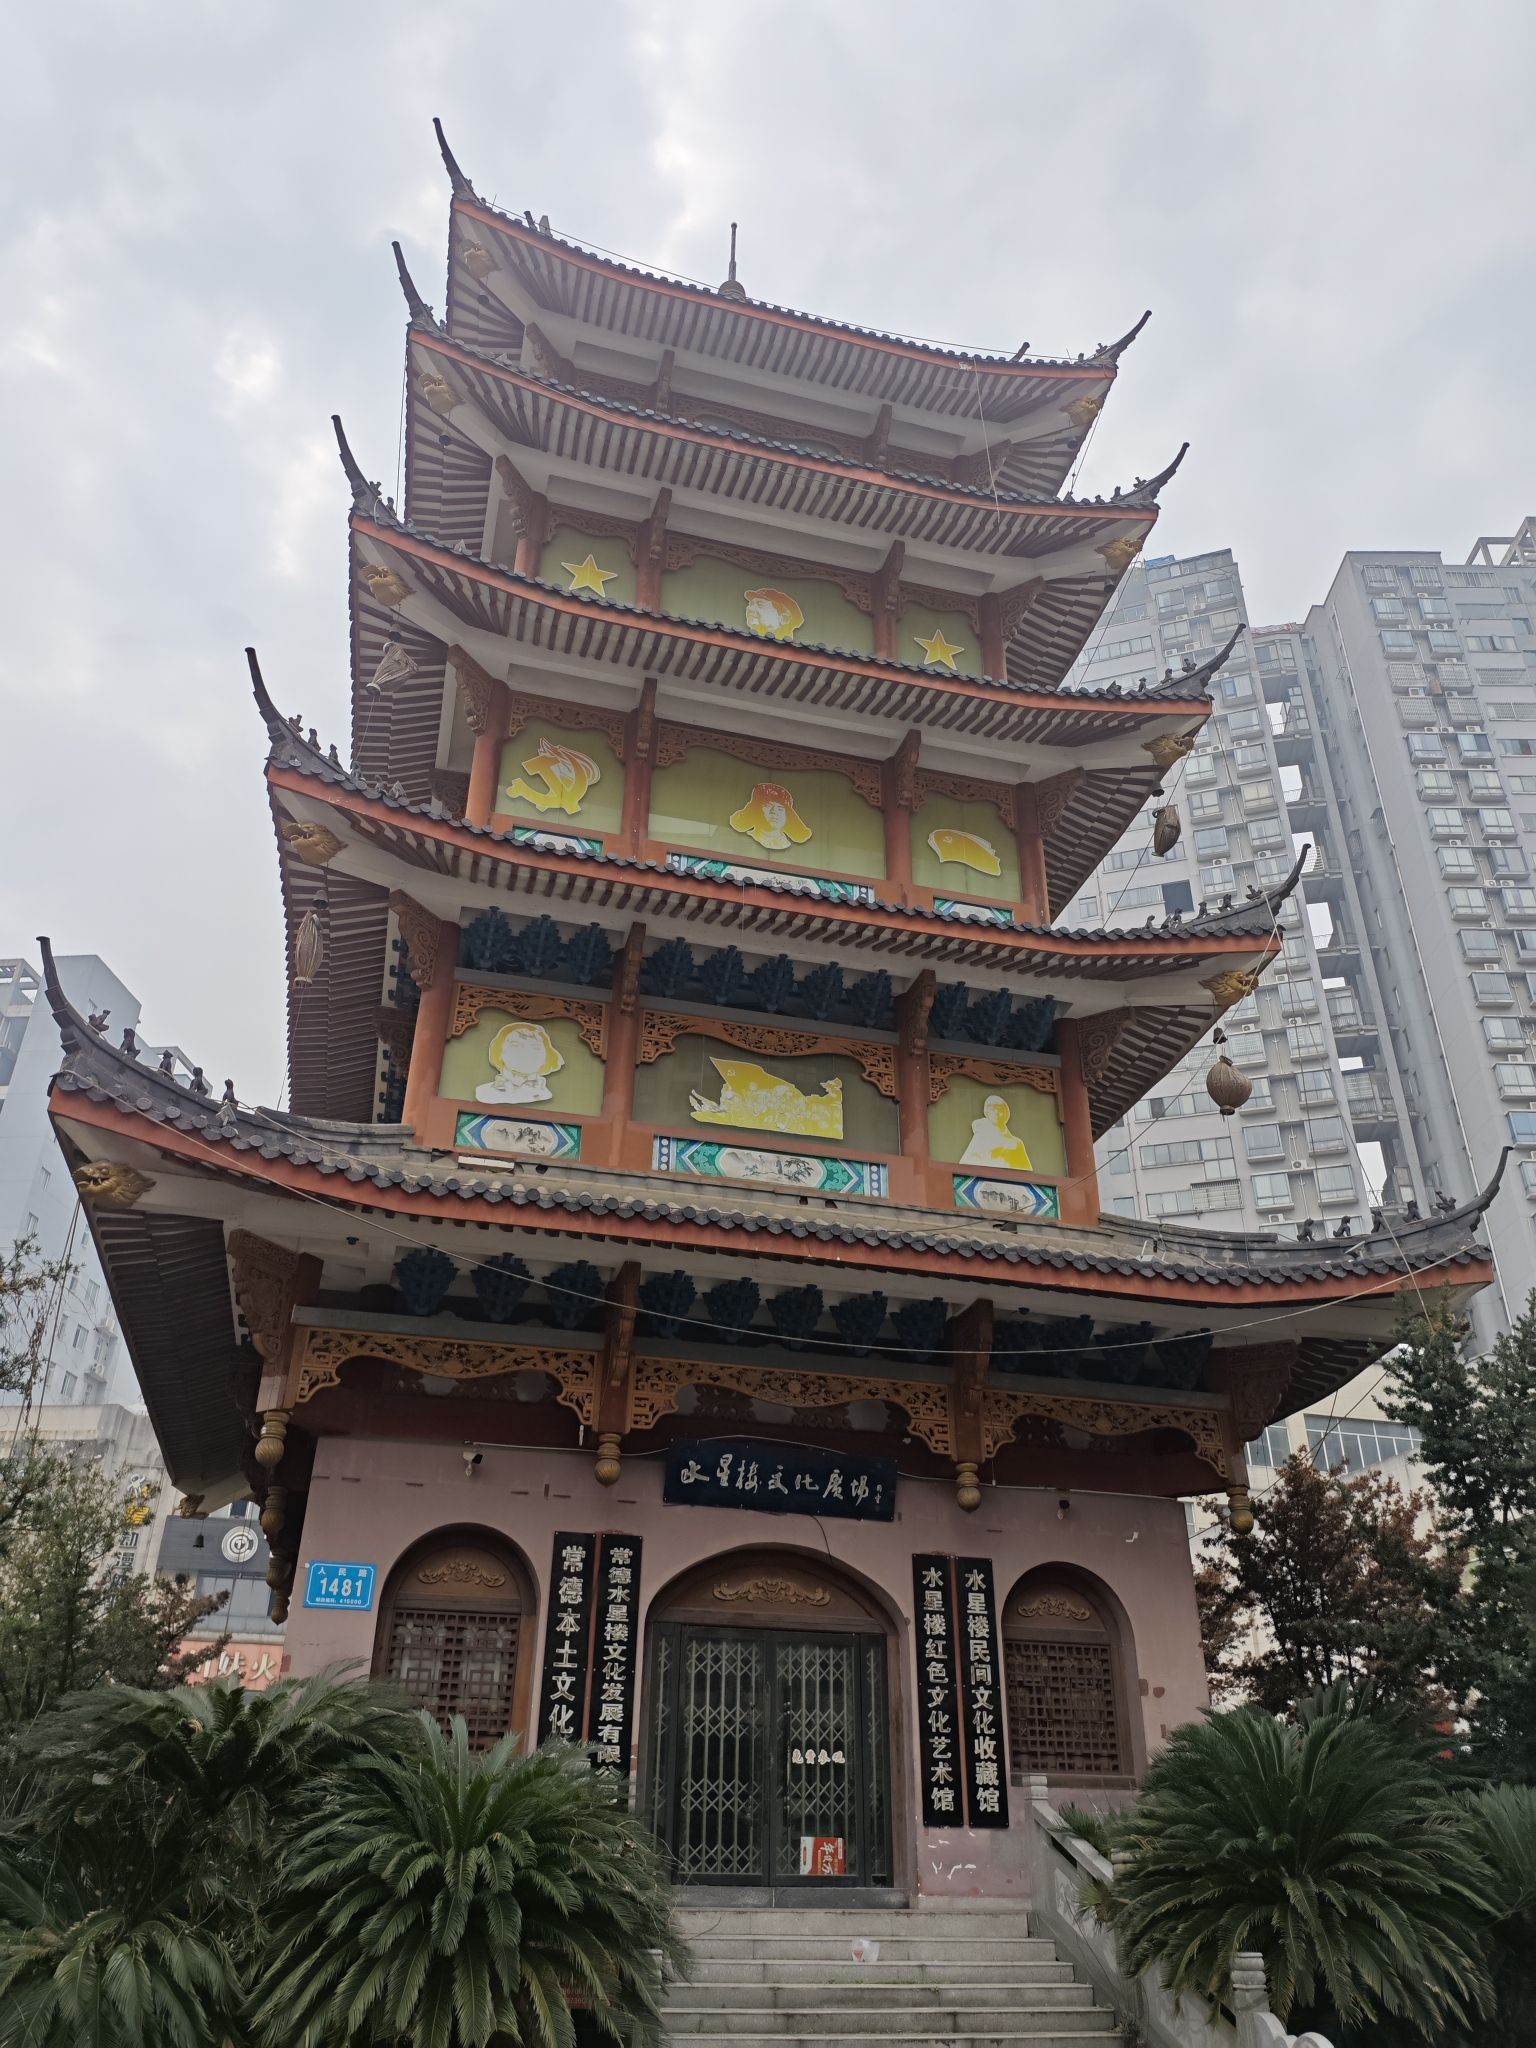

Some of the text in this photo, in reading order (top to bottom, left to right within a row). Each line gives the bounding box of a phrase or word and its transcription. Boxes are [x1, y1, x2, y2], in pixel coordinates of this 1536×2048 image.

[319, 1577, 362, 1597] 1481
[548, 1545, 586, 1747] 常德本土文化
[921, 1566, 955, 1812] 水星楼红色文化艺术馆
[964, 1568, 1000, 1813] 水星楼民间文化收藏馆
